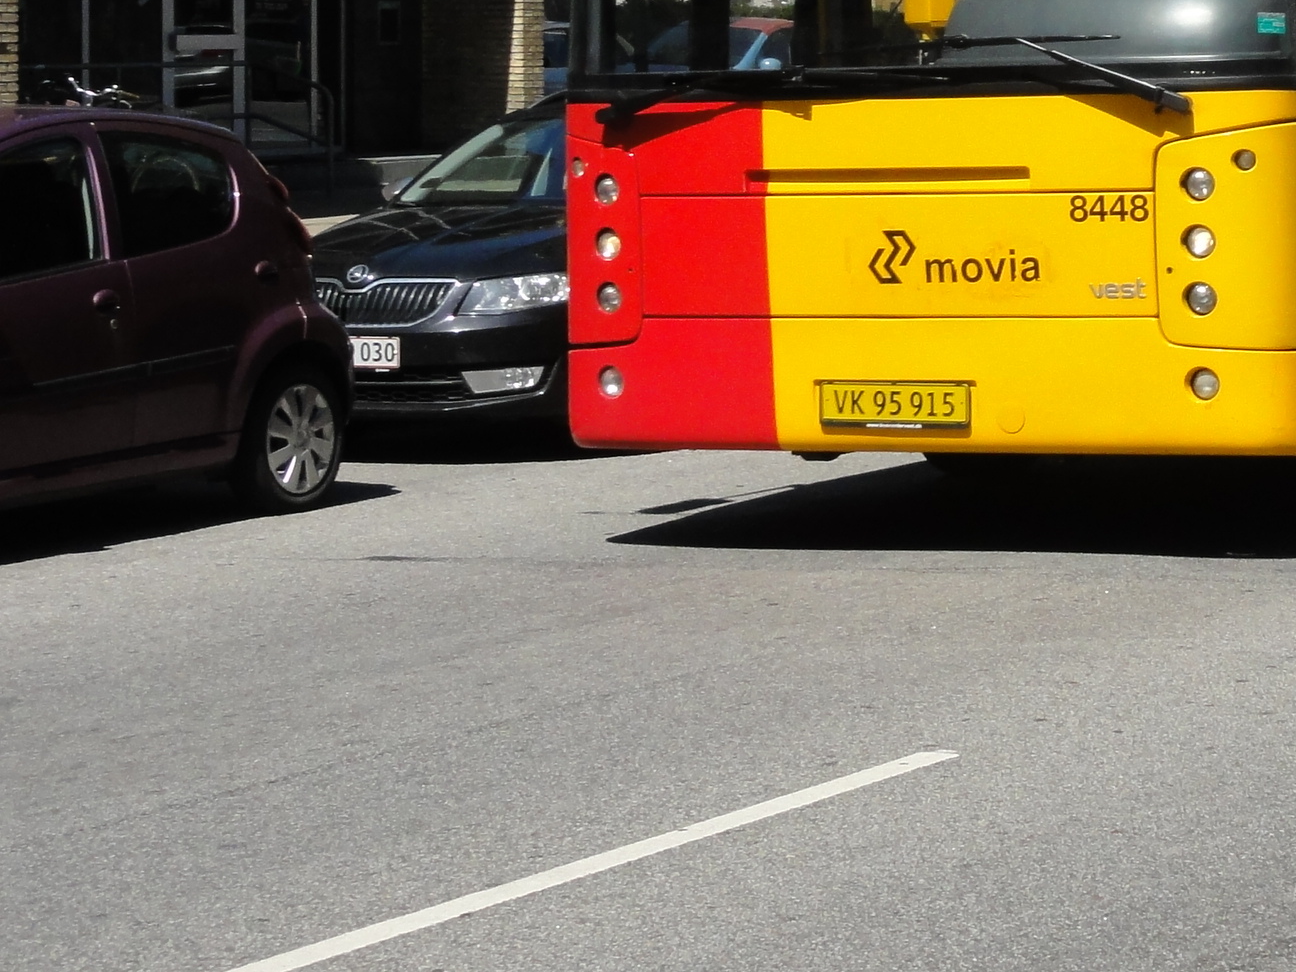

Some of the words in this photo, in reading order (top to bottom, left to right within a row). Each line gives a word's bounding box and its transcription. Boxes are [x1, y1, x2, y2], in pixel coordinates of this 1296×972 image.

[1070, 194, 1149, 223] 8448
[925, 249, 1041, 284] movia
[1088, 276, 1148, 301] vest
[361, 342, 396, 362] 030
[834, 389, 865, 415] VK
[873, 390, 902, 417] 95
[910, 391, 955, 418] 915
